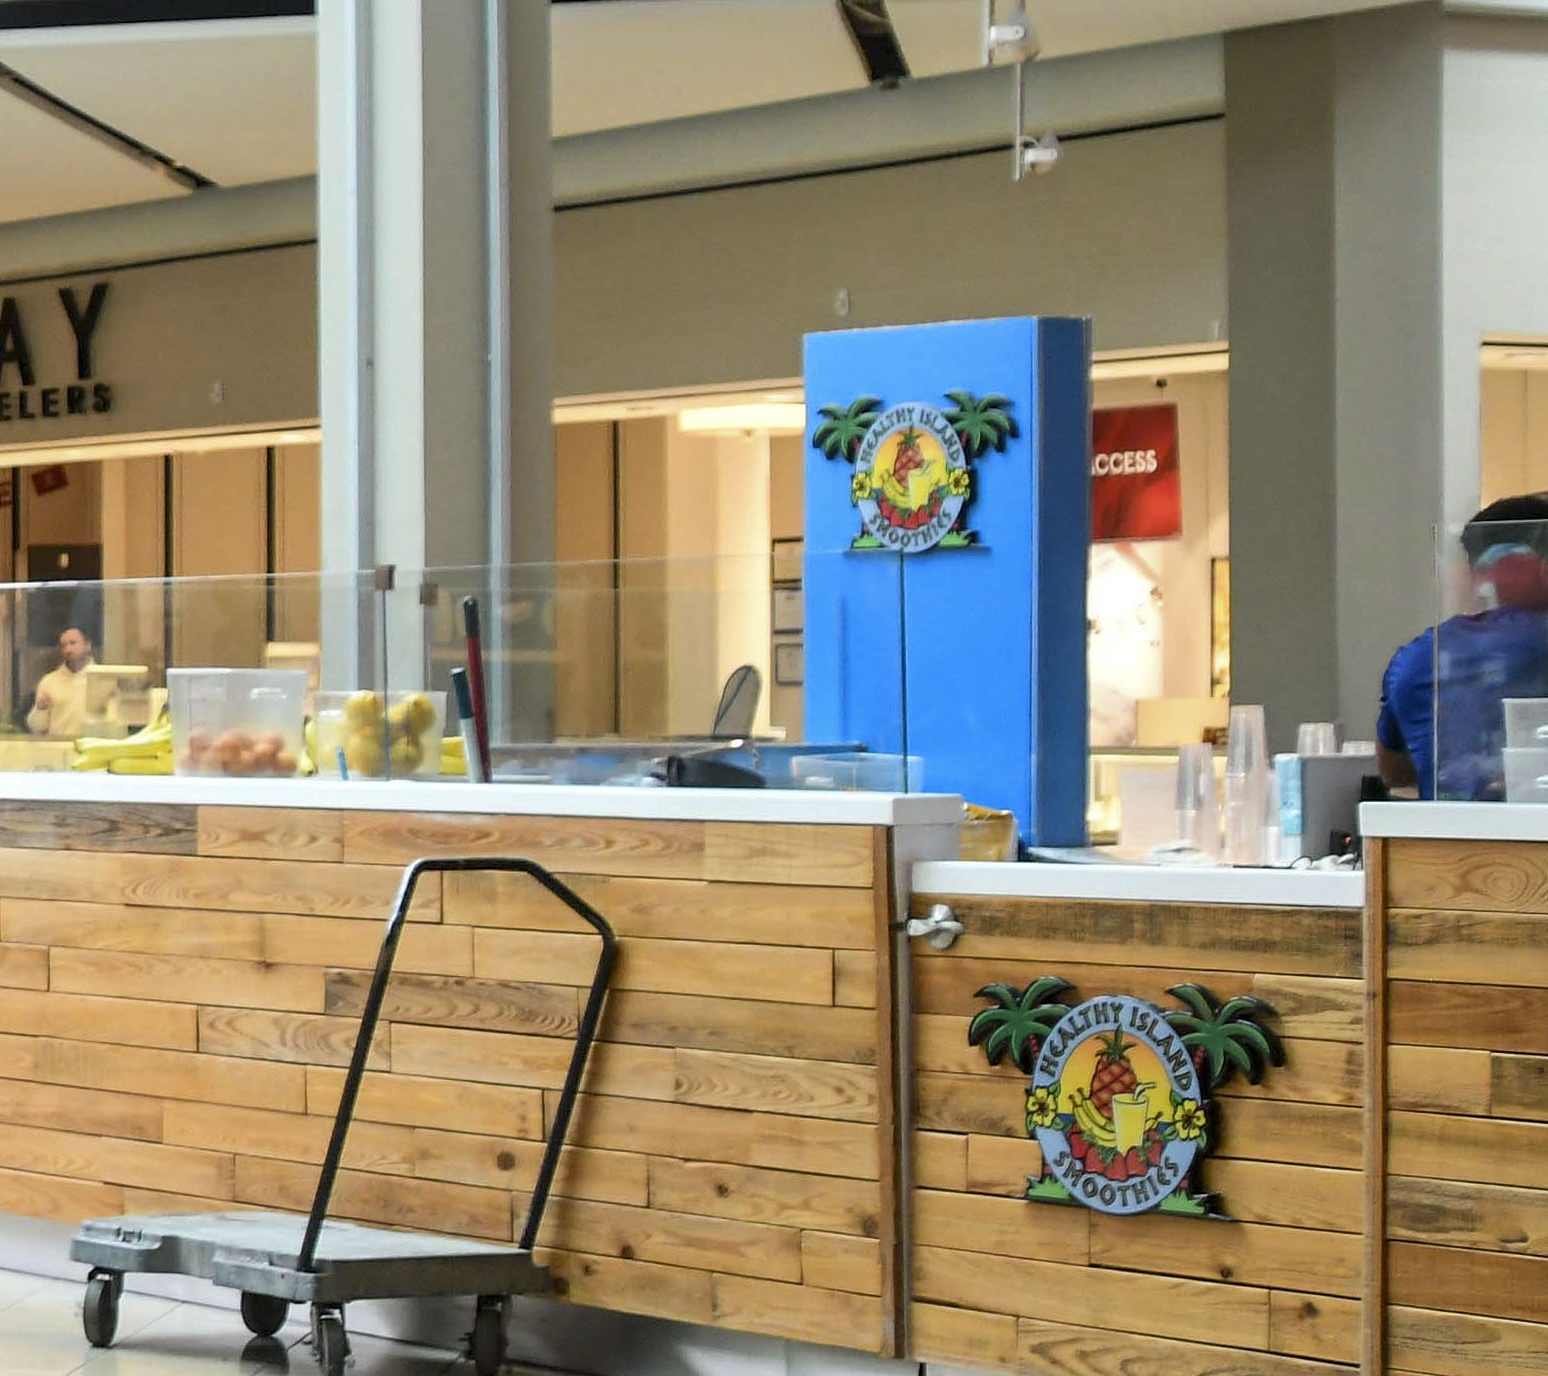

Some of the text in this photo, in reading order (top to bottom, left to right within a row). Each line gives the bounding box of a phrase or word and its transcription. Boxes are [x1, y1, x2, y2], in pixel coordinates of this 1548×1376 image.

[861, 408, 960, 463] HEALTHY ISLAND
[870, 510, 951, 547] SMOOTHIES
[1040, 1001, 1194, 1091] HEALTHY ISLAND
[1053, 1150, 1179, 1207] SMOOTHIES
